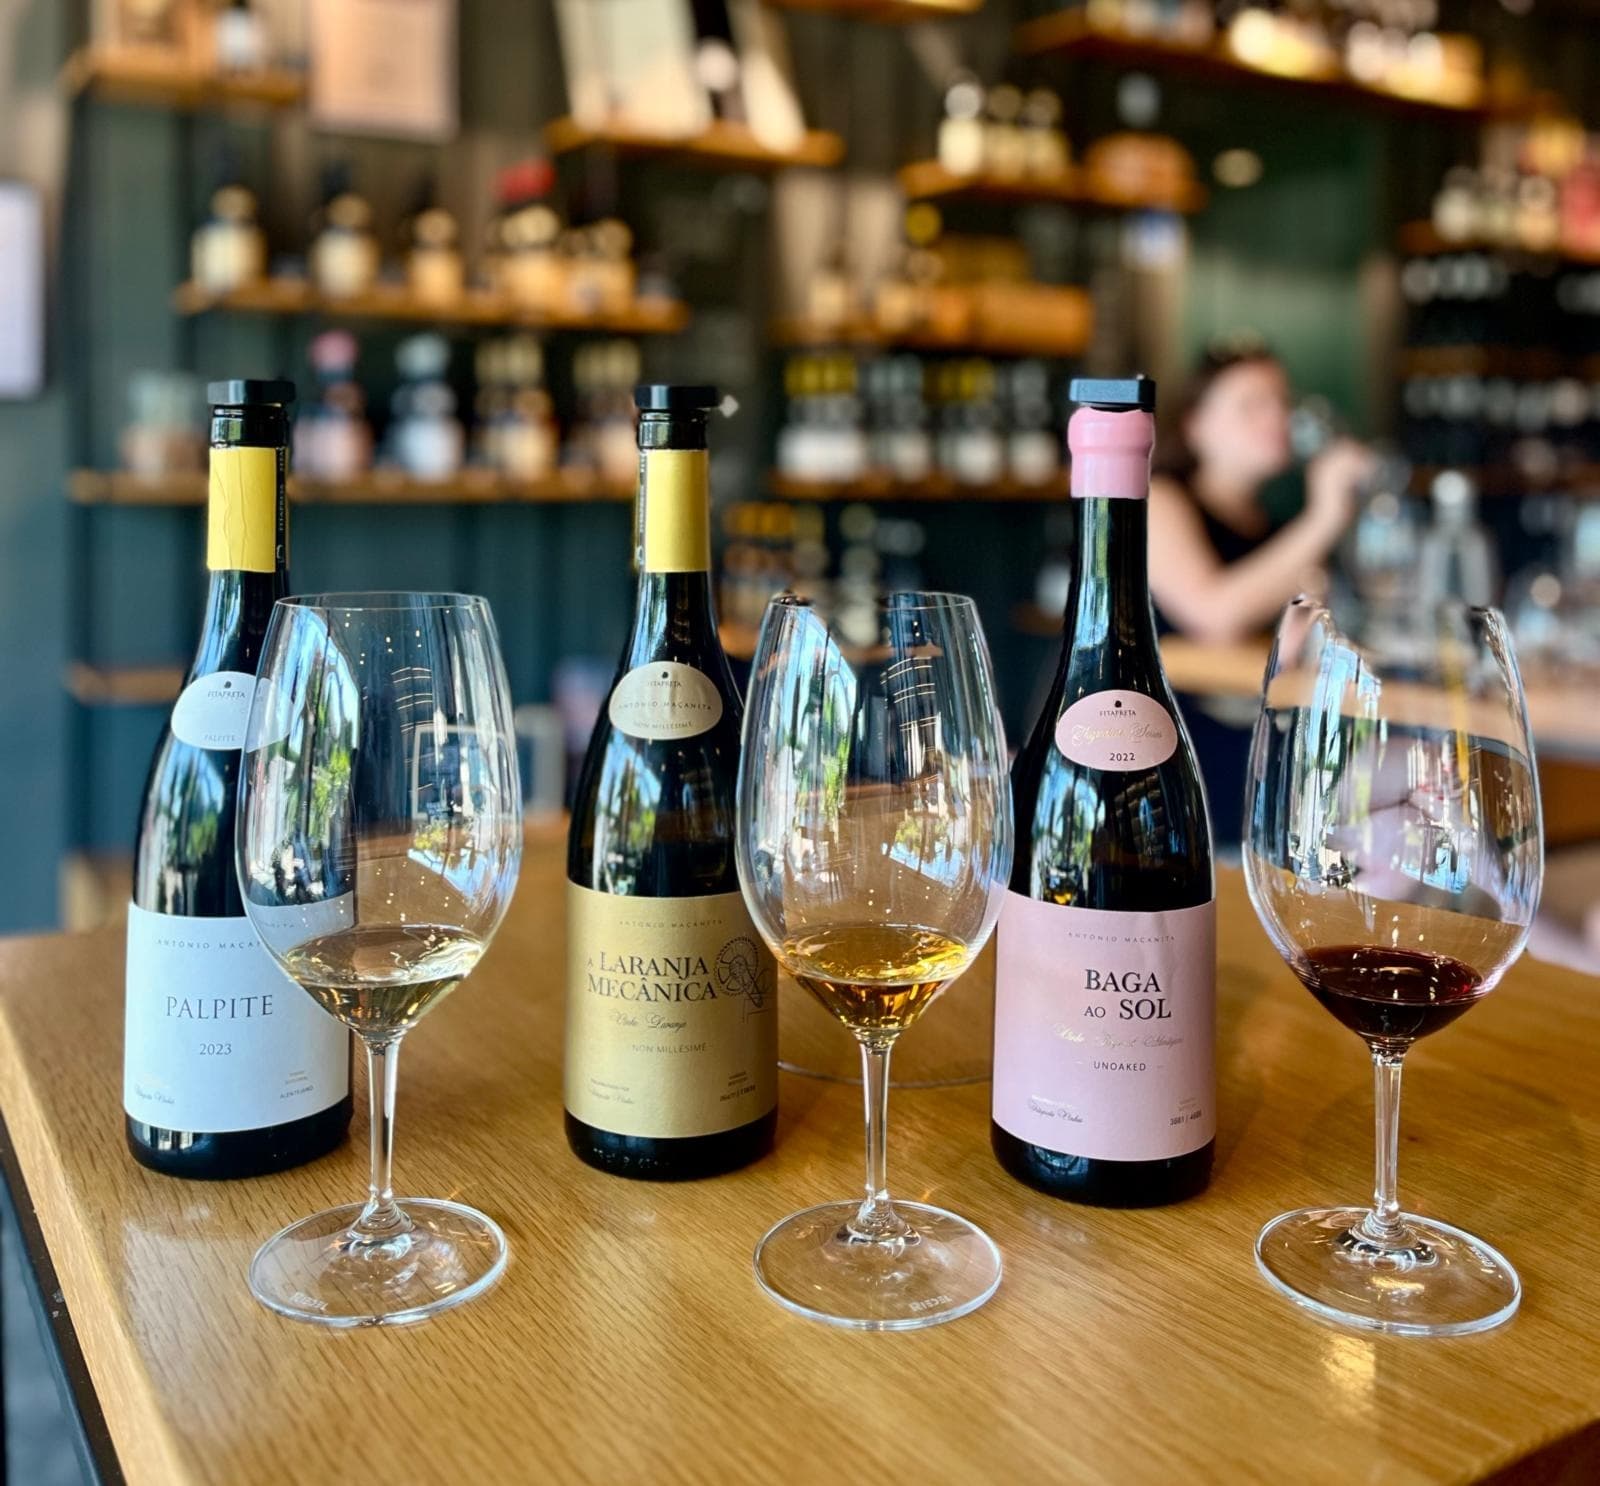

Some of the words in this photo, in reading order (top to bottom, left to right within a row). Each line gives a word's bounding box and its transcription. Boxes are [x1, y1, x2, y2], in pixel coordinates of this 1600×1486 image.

[1099, 709, 1137, 717] FITAPRETA
[1109, 752, 1136, 762] 2022
[600, 951, 710, 981] LARANJA
[587, 973, 719, 1003] MECÂNICA
[1084, 968, 1162, 994] BAGA
[166, 995, 273, 1019] PALPITE
[1084, 1005, 1107, 1019] AO
[1119, 998, 1173, 1020] SOL
[199, 1043, 233, 1056] 2023
[1093, 1060, 1148, 1073] UNOAKED
